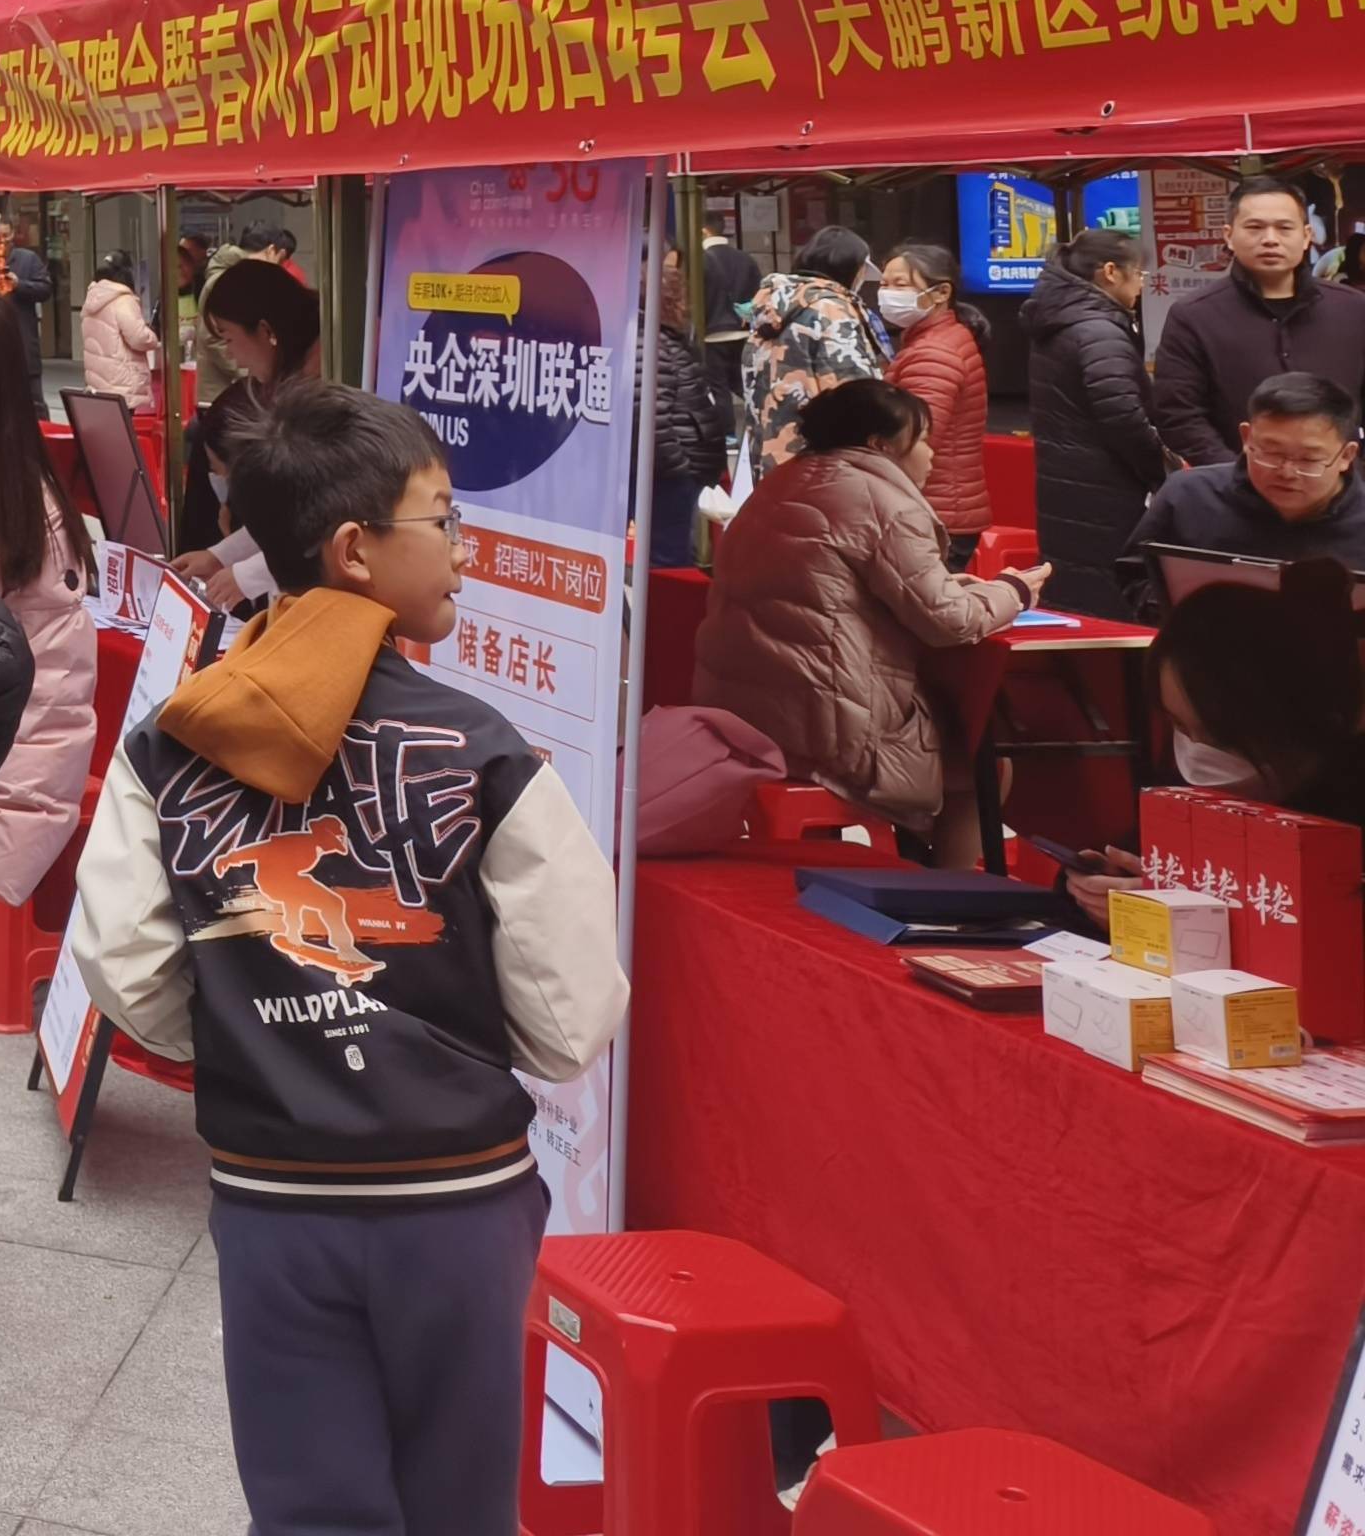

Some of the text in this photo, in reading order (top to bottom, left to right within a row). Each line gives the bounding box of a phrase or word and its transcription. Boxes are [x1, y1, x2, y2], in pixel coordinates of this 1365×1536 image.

[403, 329, 614, 425] 央企深圳联通
[446, 415, 469, 447] US
[457, 533, 603, 603] 求，招聘以下岗位
[456, 615, 558, 695] 储备店长
[324, 1028, 347, 1039] SINCE
